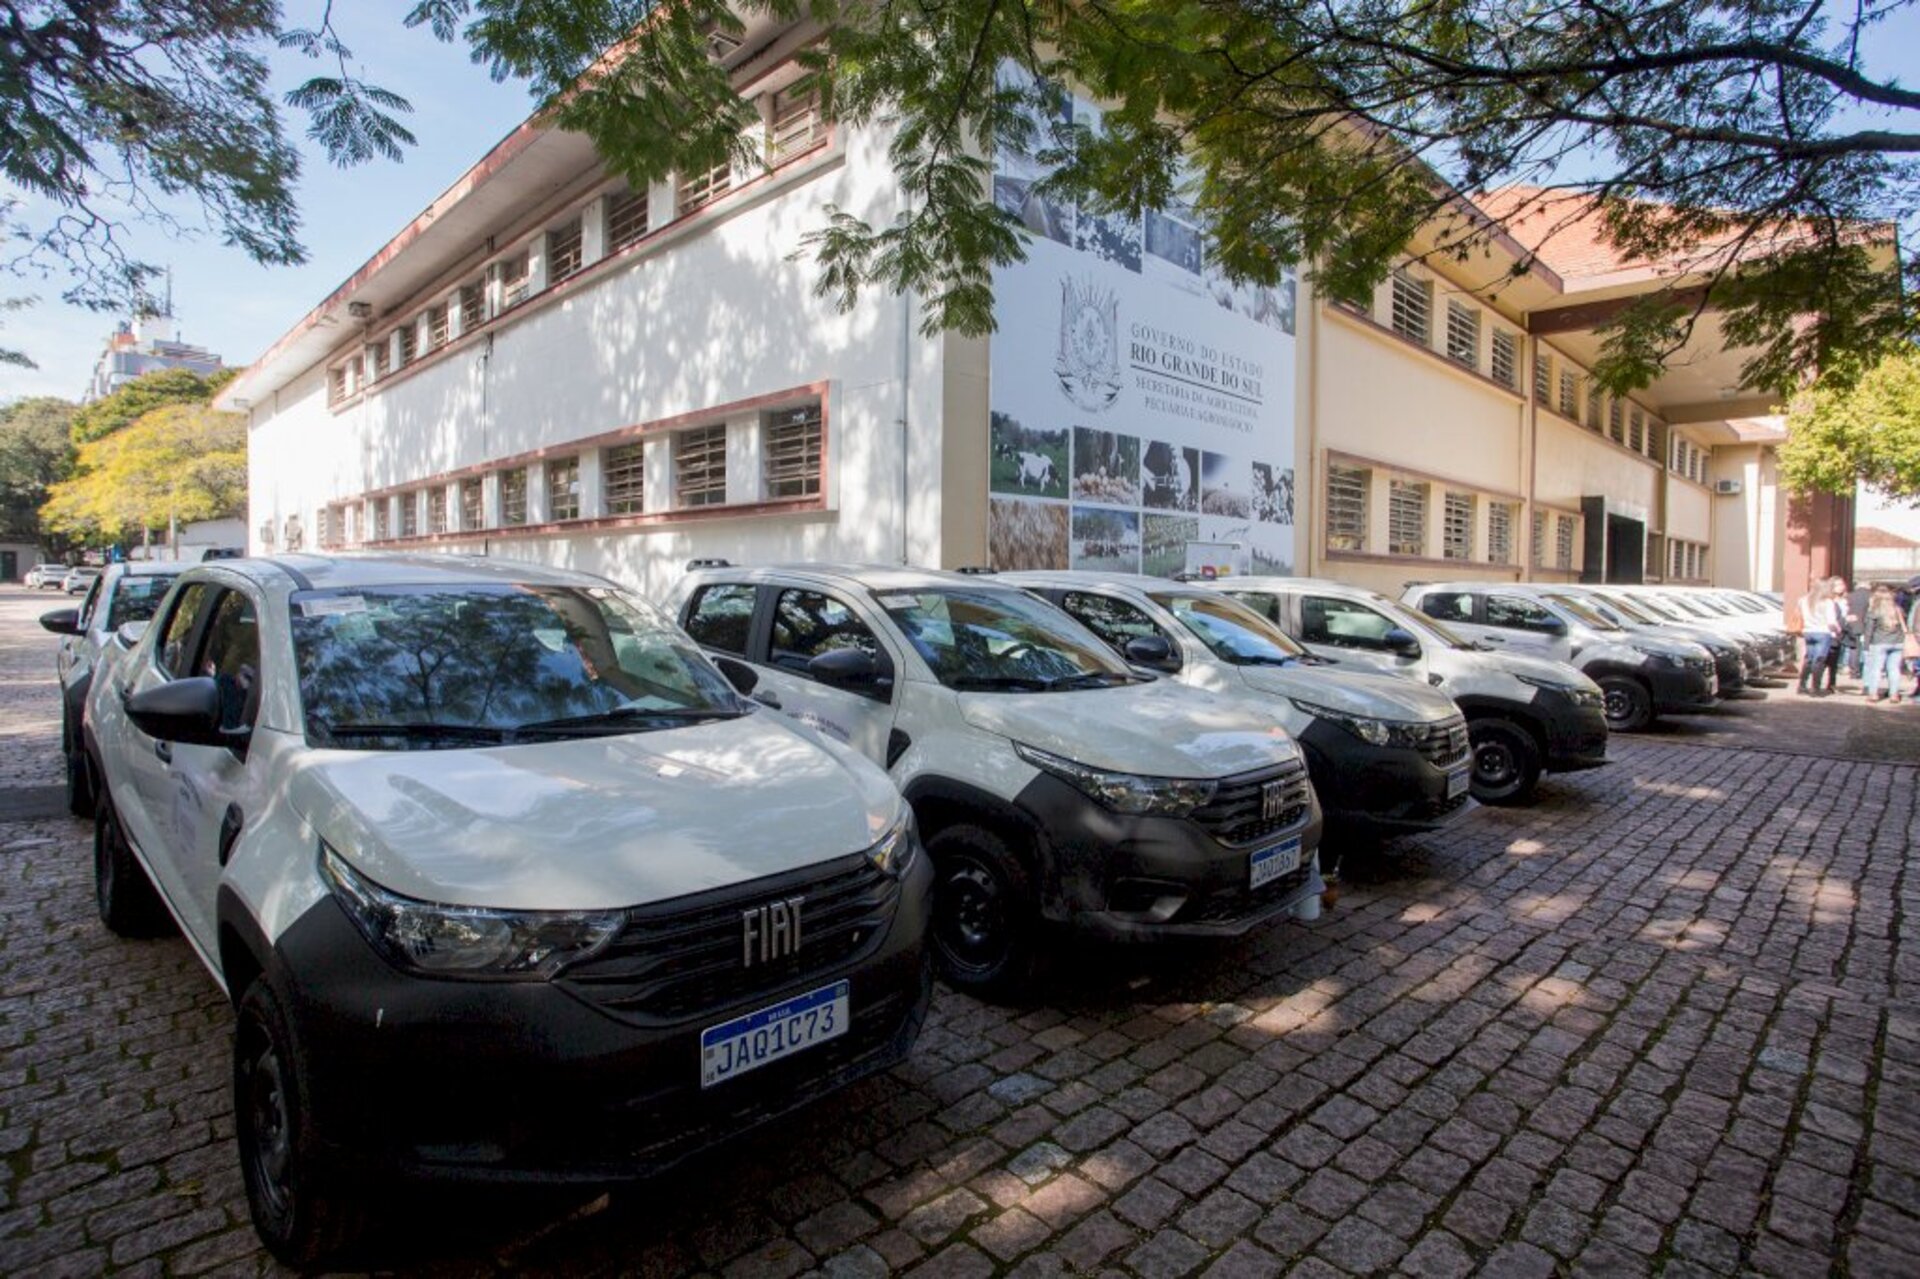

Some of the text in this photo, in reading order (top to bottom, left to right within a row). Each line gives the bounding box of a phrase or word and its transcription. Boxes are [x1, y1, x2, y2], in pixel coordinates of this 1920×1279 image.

[1131, 322, 1195, 355] GOVERNO
[1201, 345, 1217, 362] DO
[1131, 342, 1262, 398] RIO GRANDE DO SUL
[742, 896, 805, 968] FIAT
[717, 1004, 834, 1075] JAQ1C73
